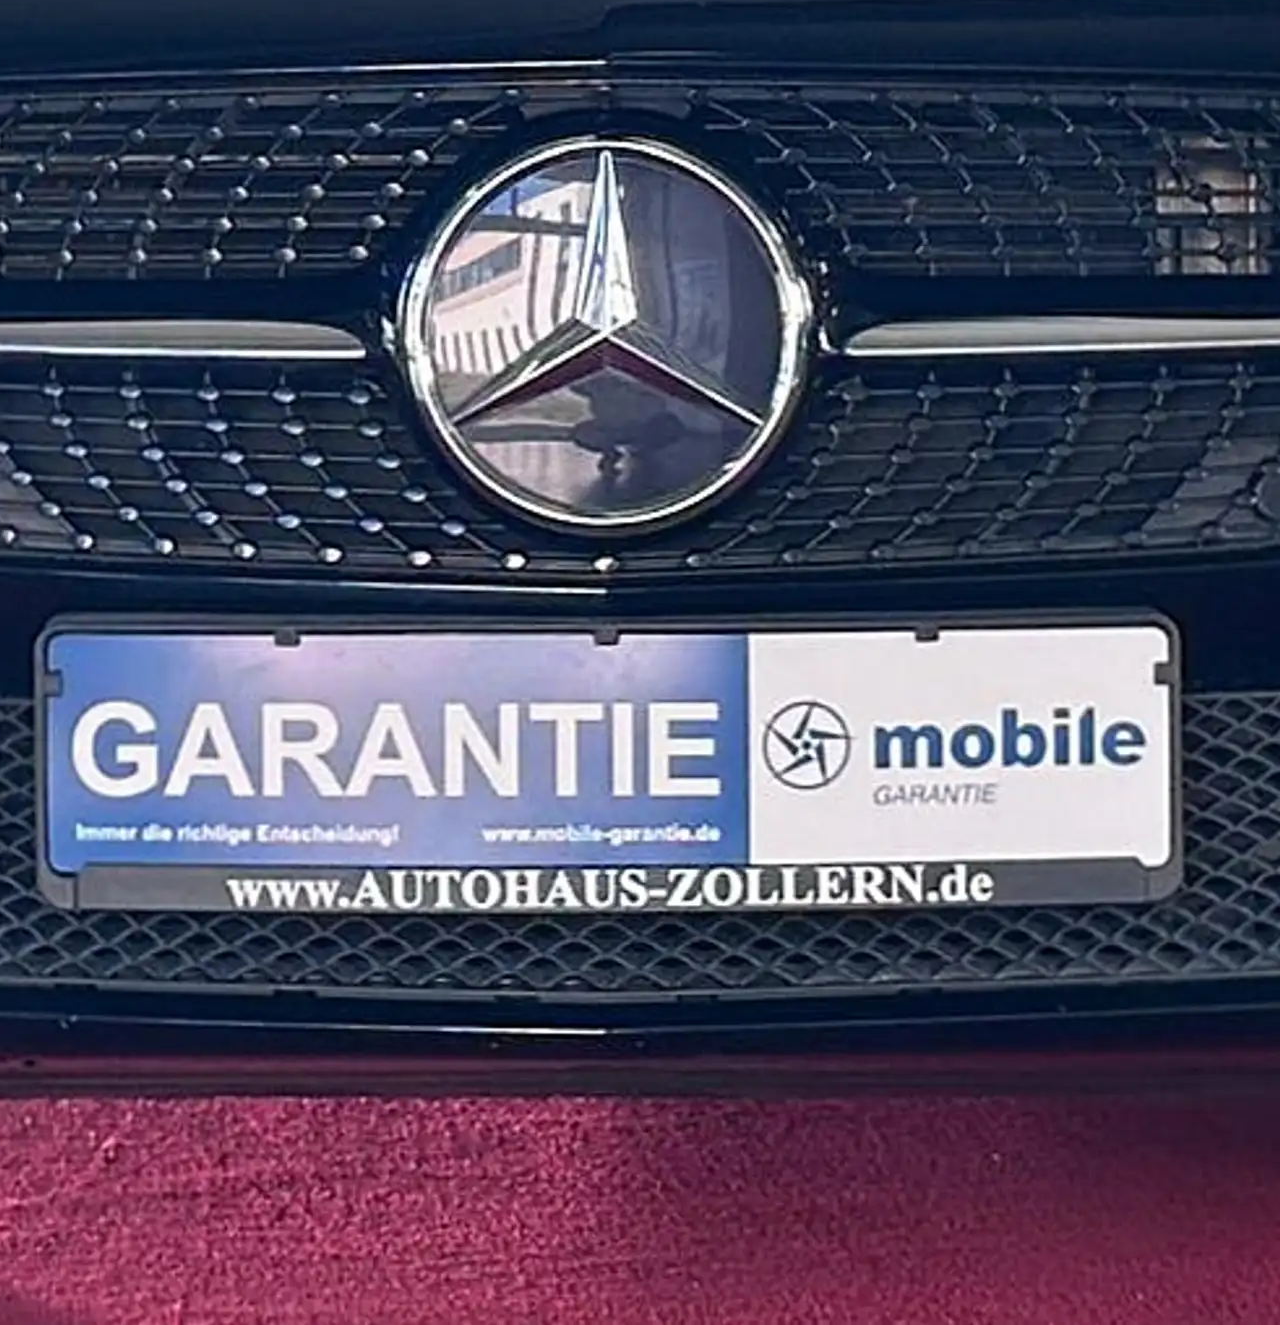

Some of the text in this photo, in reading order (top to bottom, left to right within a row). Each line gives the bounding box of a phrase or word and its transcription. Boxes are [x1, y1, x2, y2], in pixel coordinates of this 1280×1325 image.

[72, 700, 723, 798] GARANTIE
[874, 708, 1147, 768] mobile
[873, 783, 998, 806] GARANTIE
[76, 823, 401, 848] Immer die richtige Entscheidung!
[481, 823, 722, 846] www.mobile-garantie.de
[226, 864, 995, 910] www.AUTOHAUS-ZOLLERN.de
